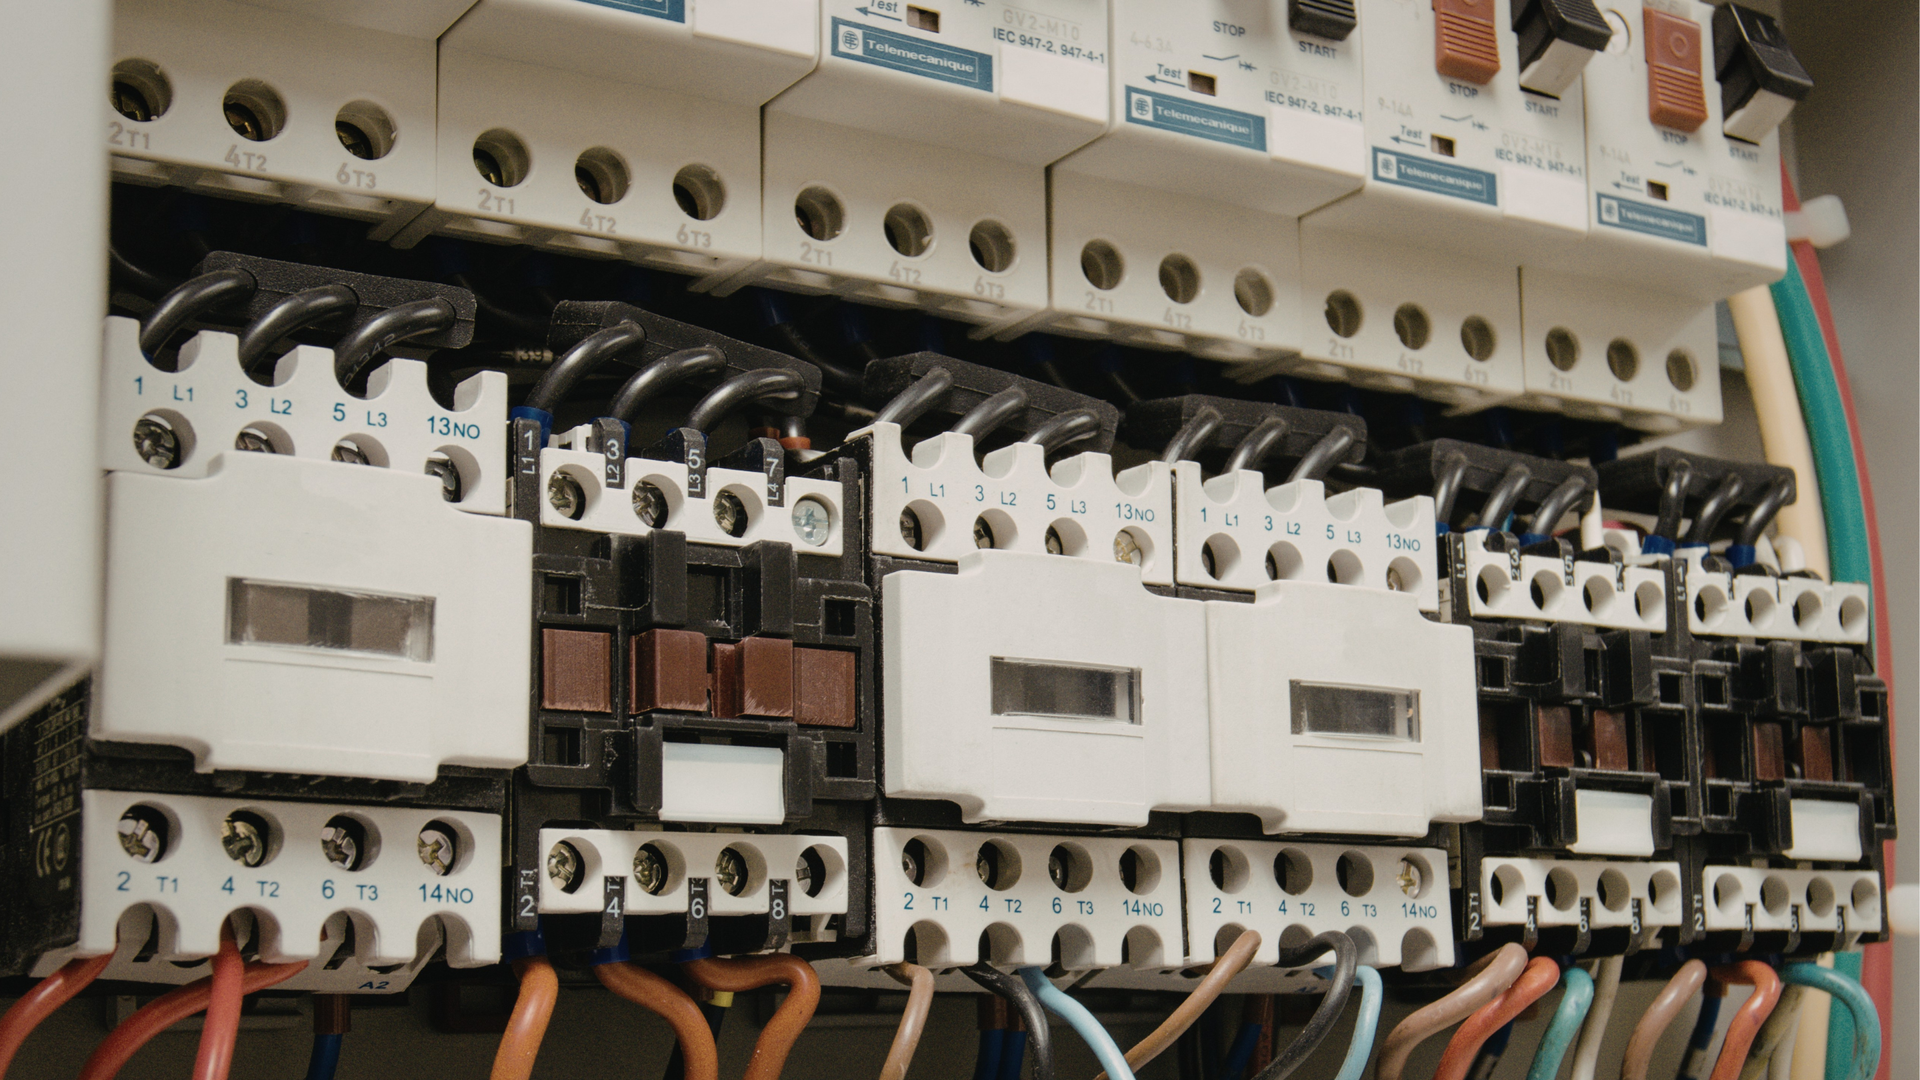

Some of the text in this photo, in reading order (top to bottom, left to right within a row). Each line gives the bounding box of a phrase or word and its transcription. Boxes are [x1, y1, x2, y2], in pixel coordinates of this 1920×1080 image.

[1003, 8, 1081, 40] GV2-M10
[1213, 20, 1246, 38] STOP
[993, 27, 1016, 43] IEC
[1061, 45, 1105, 64] 947-4-1
[1299, 40, 1337, 59] START
[866, 39, 975, 73] Telemecanique
[1157, 63, 1182, 79] Test
[1450, 82, 1478, 98] STOP
[1265, 90, 1285, 105] IEC
[1324, 104, 1362, 122] 947-4-1
[1525, 101, 1558, 118] START
[1155, 105, 1250, 135] Telemecanique
[1400, 125, 1422, 139] Test
[1662, 131, 1688, 146] STOP
[1495, 148, 1513, 161] IEC
[1547, 160, 1582, 177] 947-4-1
[1729, 147, 1758, 164] START
[1400, 164, 1483, 191] Telemecanique
[1621, 170, 1640, 185] Test
[1704, 192, 1720, 205] IEC
[134, 376, 195, 402] 1 L1
[235, 389, 292, 416] 3 L2
[333, 403, 388, 428] 5 L3
[524, 430, 533, 450] 1
[607, 438, 619, 460] 3
[522, 457, 535, 475] L1
[688, 449, 700, 468] 5
[766, 458, 779, 477] 7
[606, 463, 620, 483] L2
[688, 473, 701, 492] L3
[768, 482, 779, 501] L4
[902, 476, 945, 498] 1 L1
[975, 485, 1017, 506] 3 L2
[1047, 494, 1087, 514] 5 L3
[1200, 507, 1239, 527] 1 L1
[1264, 516, 1301, 535] 3 L2
[1326, 524, 1362, 543] 5 L3
[1457, 542, 1464, 559] 1
[1510, 549, 1519, 565] 3
[1457, 563, 1467, 578] L1
[1565, 555, 1573, 572] 5
[1614, 562, 1623, 578] 7
[1677, 566, 1684, 583] 1
[117, 872, 179, 893] 2 T1
[221, 876, 280, 897] 4 T2
[521, 869, 536, 889] T1
[322, 880, 378, 901] 6 T3
[521, 895, 534, 917] 2
[606, 897, 620, 918] 4
[691, 899, 704, 919] 6
[772, 900, 785, 920] 8
[904, 893, 948, 911] 2 T1
[979, 895, 1022, 913] 4 T2
[1052, 897, 1094, 915] 6 T3
[1212, 898, 1251, 914] 2 T1
[1278, 900, 1315, 916] 4 T2
[1341, 901, 1377, 917] 6 T3
[1470, 914, 1480, 931] 2
[1526, 914, 1536, 932] 4
[1579, 916, 1588, 933] 6
[1631, 917, 1640, 934] 8
[1695, 914, 1704, 931] 2
[358, 980, 390, 990] A2
